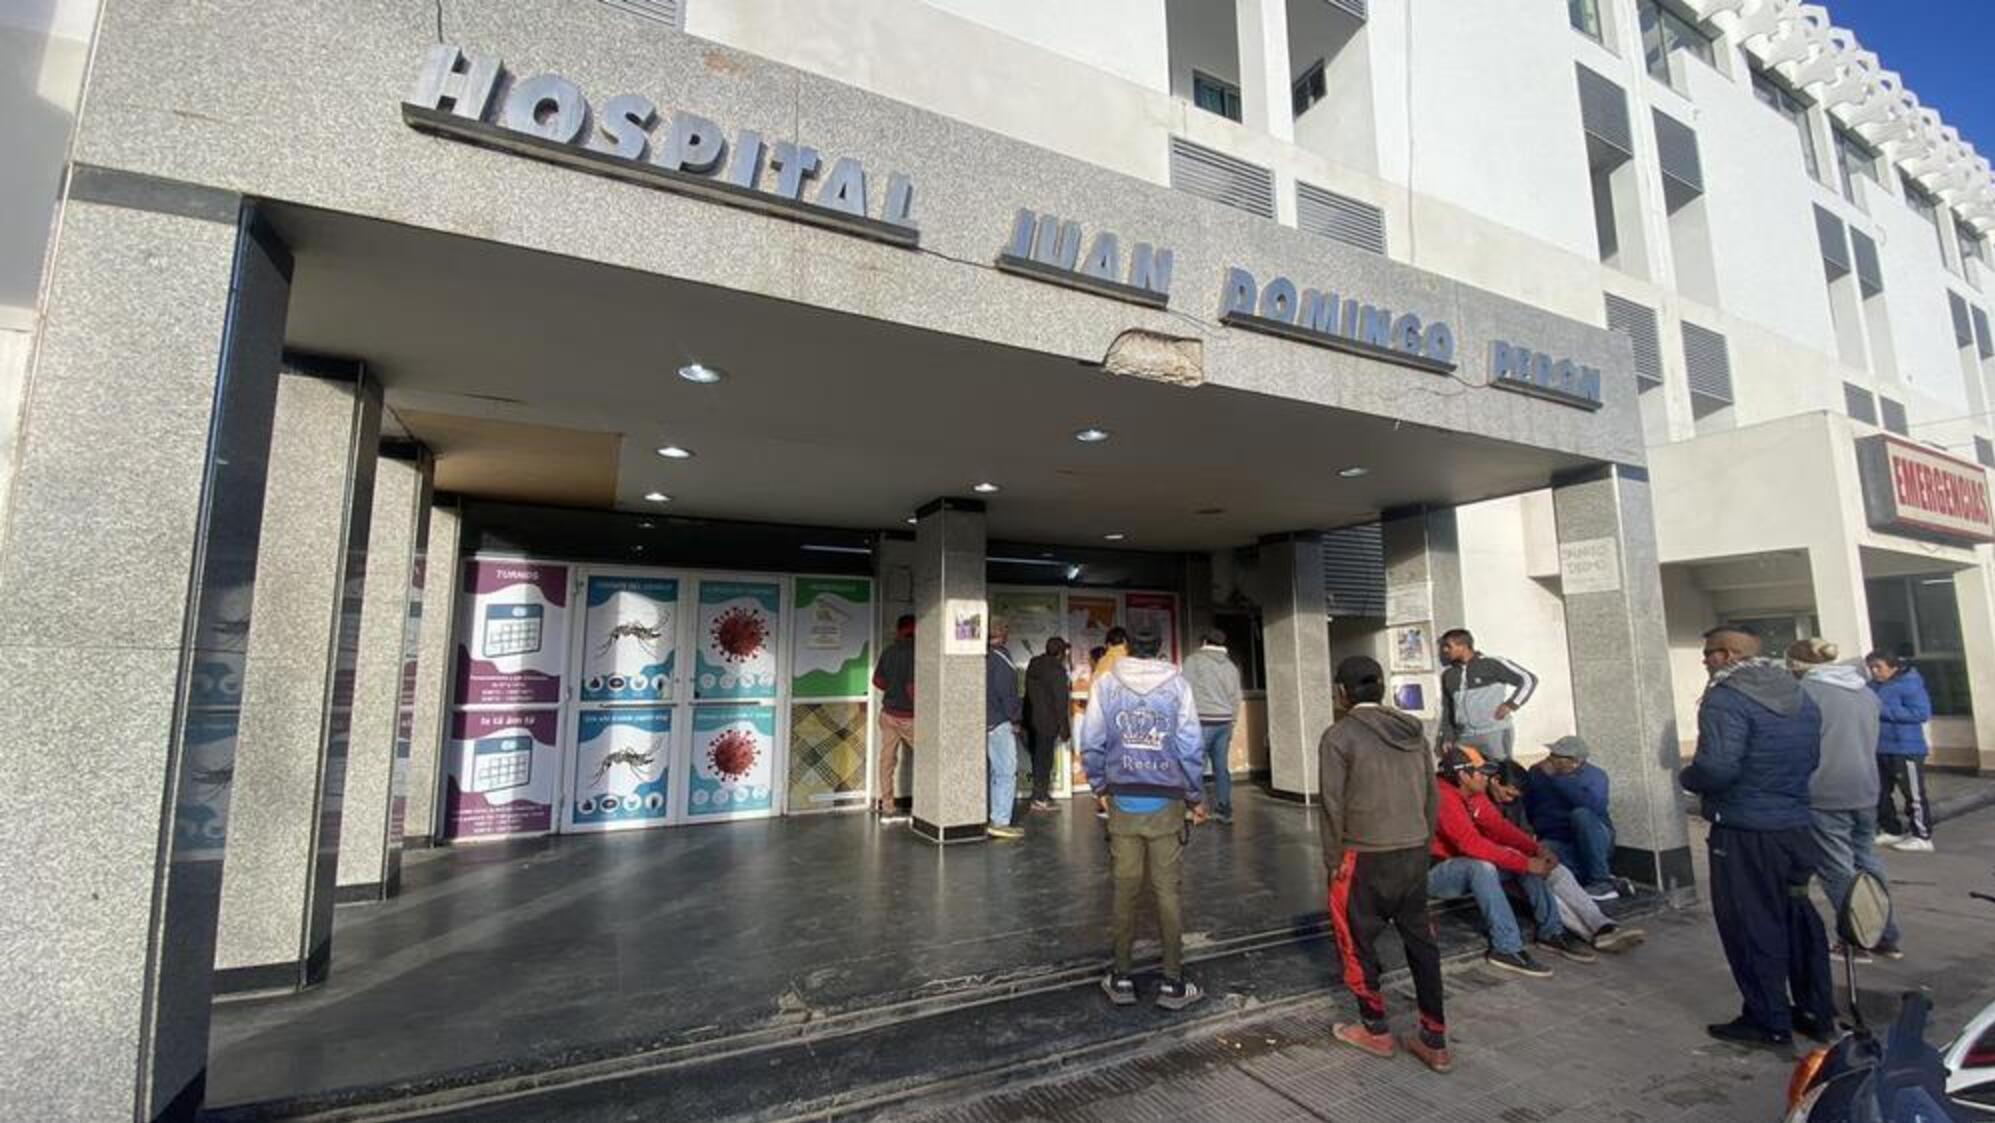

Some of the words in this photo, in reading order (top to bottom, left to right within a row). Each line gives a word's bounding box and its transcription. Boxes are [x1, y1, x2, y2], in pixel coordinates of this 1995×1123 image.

[403, 44, 918, 227] HOSPITAL
[1002, 207, 1174, 295] JUAN
[1219, 266, 1454, 362] DOMINGO
[1892, 455, 1989, 526] EMERGENCIAS
